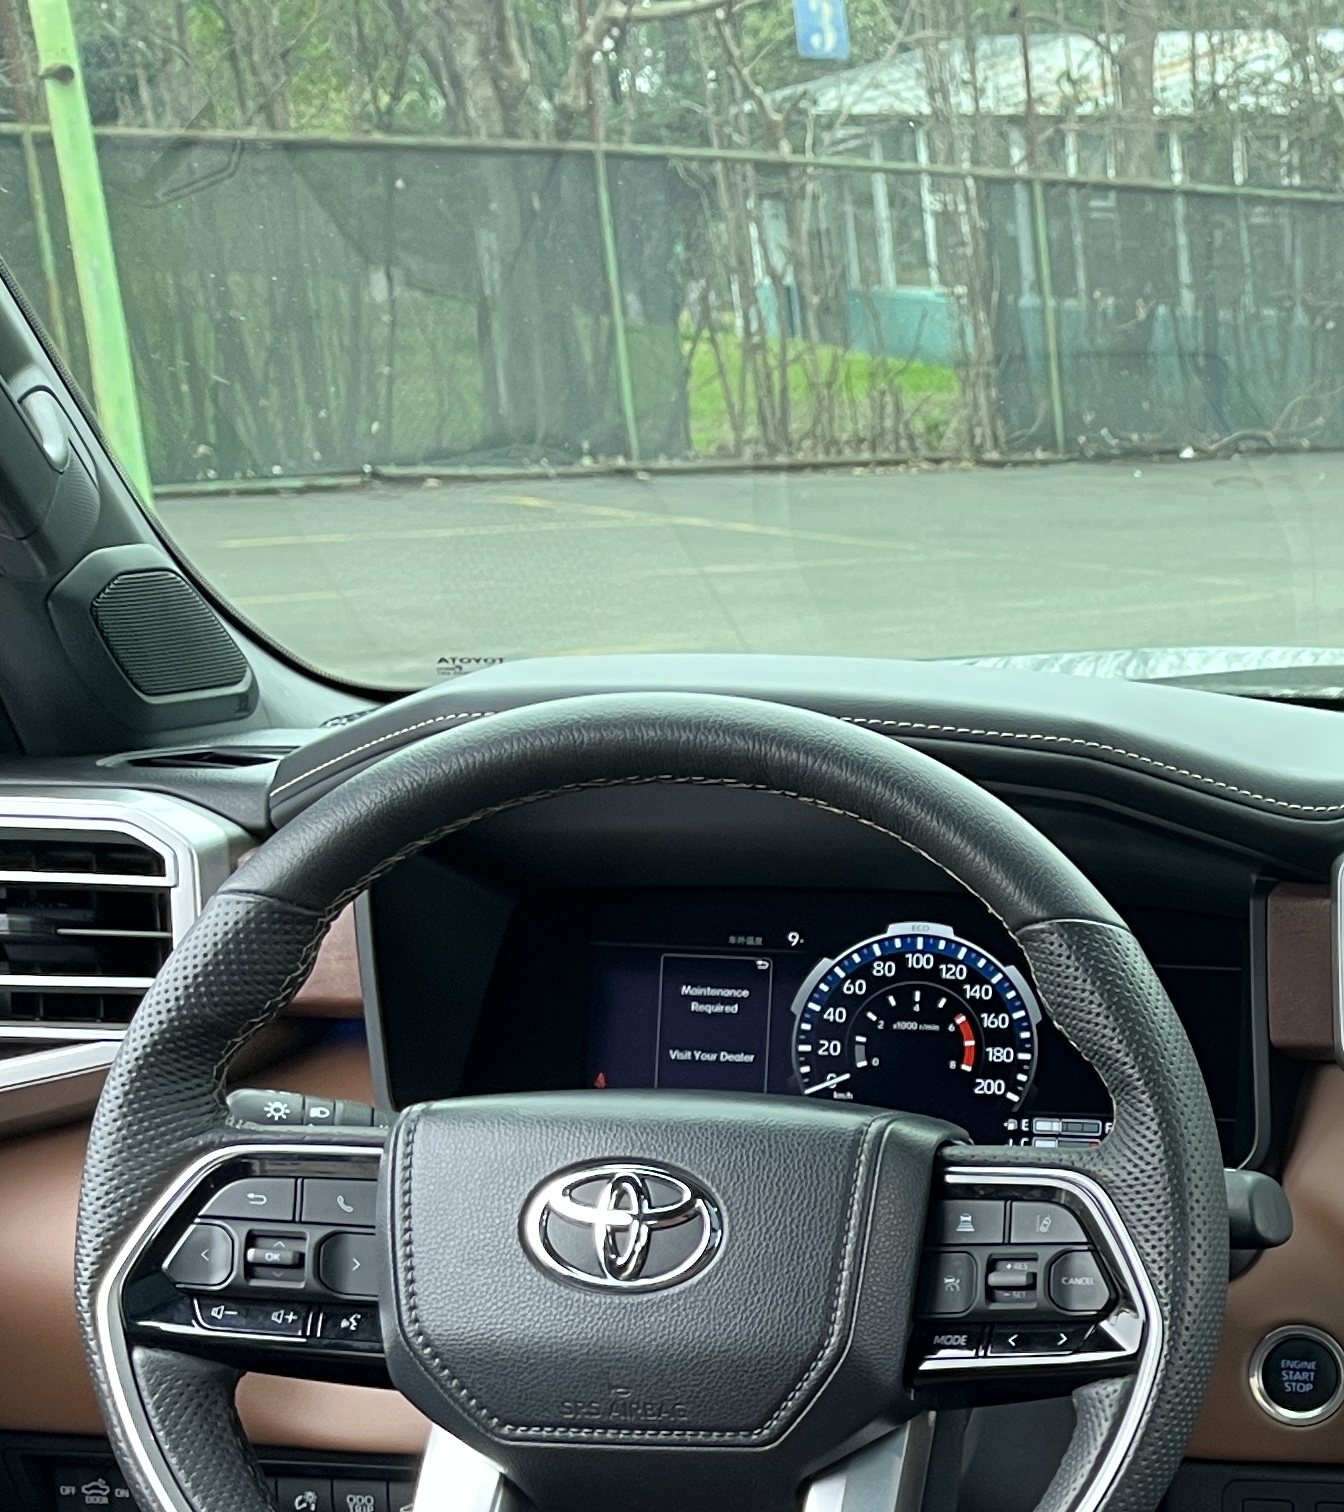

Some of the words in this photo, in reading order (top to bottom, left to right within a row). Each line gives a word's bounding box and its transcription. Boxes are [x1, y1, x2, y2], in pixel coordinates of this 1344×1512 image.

[905, 953, 934, 969] 100
[872, 961, 896, 977] 80
[938, 963, 967, 981] 120
[680, 984, 750, 998] Maintenance
[843, 978, 867, 995] 60
[963, 984, 993, 1000] 140
[691, 1001, 739, 1014] Required
[823, 1006, 847, 1023] 40
[980, 1012, 1010, 1028] 160
[818, 1040, 841, 1056] 20
[985, 1047, 1014, 1062] 180
[668, 1049, 692, 1061] Visit
[693, 1050, 718, 1061] Your
[720, 1051, 756, 1063] Dealer
[974, 1078, 1006, 1096] 200
[1021, 1118, 1030, 1131] E
[264, 1252, 281, 1262] OK
[1061, 1276, 1095, 1286] CANCEL
[933, 1334, 968, 1346] MODE
[1281, 1359, 1317, 1370] ENGINE
[1281, 1370, 1315, 1381] START
[1284, 1381, 1313, 1393] STOP
[346, 1494, 375, 1505] ODO
